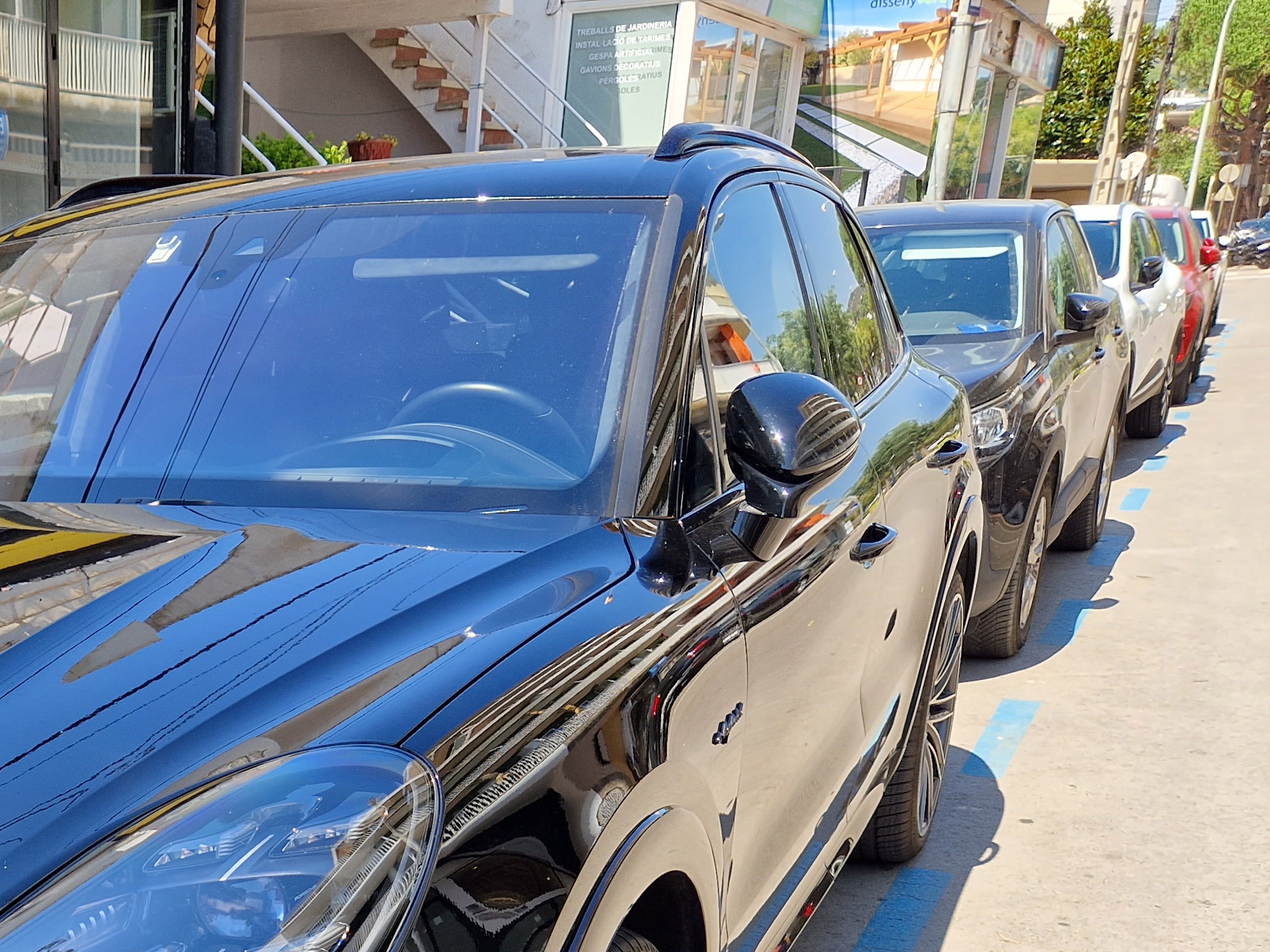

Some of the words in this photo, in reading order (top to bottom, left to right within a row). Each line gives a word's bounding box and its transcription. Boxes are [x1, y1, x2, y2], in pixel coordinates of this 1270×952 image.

[576, 26, 615, 36] TREBALLS
[615, 24, 626, 33] DE
[627, 21, 673, 32] JARDINERIA
[626, 36, 637, 45] DE
[637, 33, 670, 44] TARIMES
[588, 52, 613, 61] GESPA
[614, 48, 654, 58] ARTIFICIAL
[580, 64, 612, 74] GAVIONS
[613, 60, 661, 71] DECORATIUS
